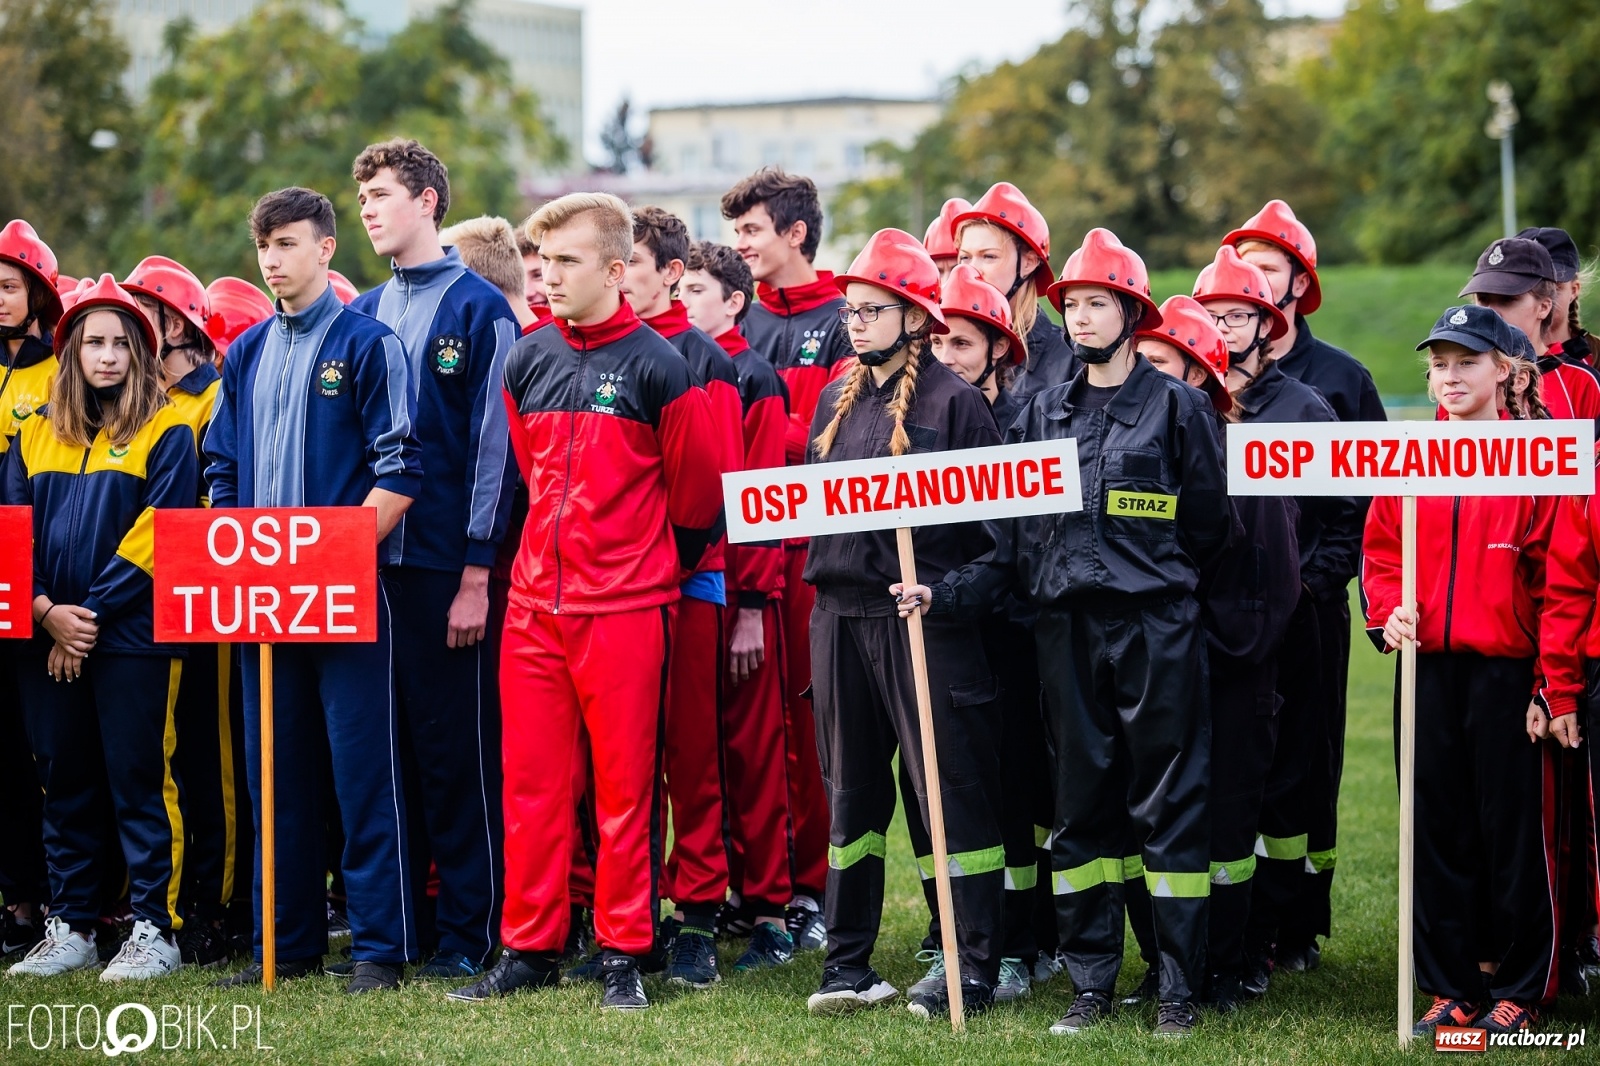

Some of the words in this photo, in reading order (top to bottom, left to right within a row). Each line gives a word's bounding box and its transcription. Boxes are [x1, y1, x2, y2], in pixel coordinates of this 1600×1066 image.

[439, 338, 463, 348] OSP
[600, 373, 623, 382] OSP
[590, 404, 615, 414] TURZE
[1244, 439, 1315, 479] OSP
[1331, 436, 1579, 478] KRZANOWICE
[740, 482, 808, 525] OSP
[823, 456, 1065, 516] KRZANOWICE
[206, 515, 321, 566] OSP
[172, 584, 358, 635] TURZE
[158, 958, 171, 971] FILA
